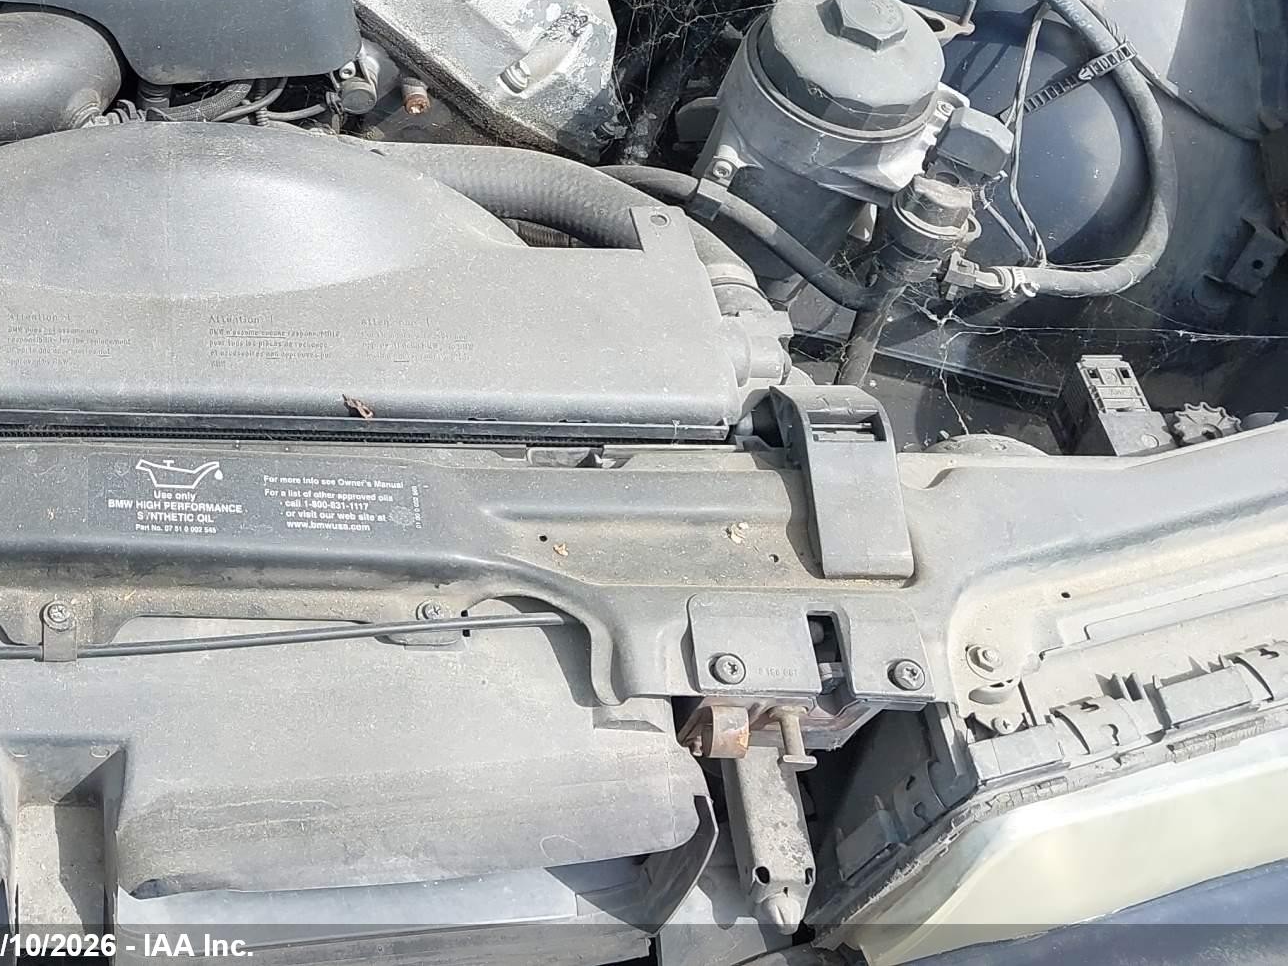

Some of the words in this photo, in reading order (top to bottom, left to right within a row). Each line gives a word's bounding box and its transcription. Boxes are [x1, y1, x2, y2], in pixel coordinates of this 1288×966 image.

[264, 475, 277, 484] For
[303, 476, 319, 485] info
[337, 478, 372, 488] Owner's
[374, 480, 404, 489] Manual
[153, 490, 172, 499] Use
[175, 491, 196, 502] only
[264, 488, 278, 497] For
[288, 489, 302, 498] list
[303, 490, 312, 498] of
[313, 490, 336, 499] other
[337, 492, 376, 502] approved
[378, 494, 394, 502] oils
[108, 498, 133, 508] BMW
[136, 500, 161, 510] HIGH
[164, 501, 243, 513] PERFORMANCE
[285, 499, 301, 508] call
[197, 513, 214, 523] OIL
[298, 510, 317, 519] visit
[319, 512, 335, 520] our
[338, 512, 356, 521] web
[358, 513, 375, 522] site
[377, 514, 386, 522] at
[136, 523, 149, 531] Part
[151, 524, 163, 532] No.
[286, 519, 371, 531] www.bmwusa.com
